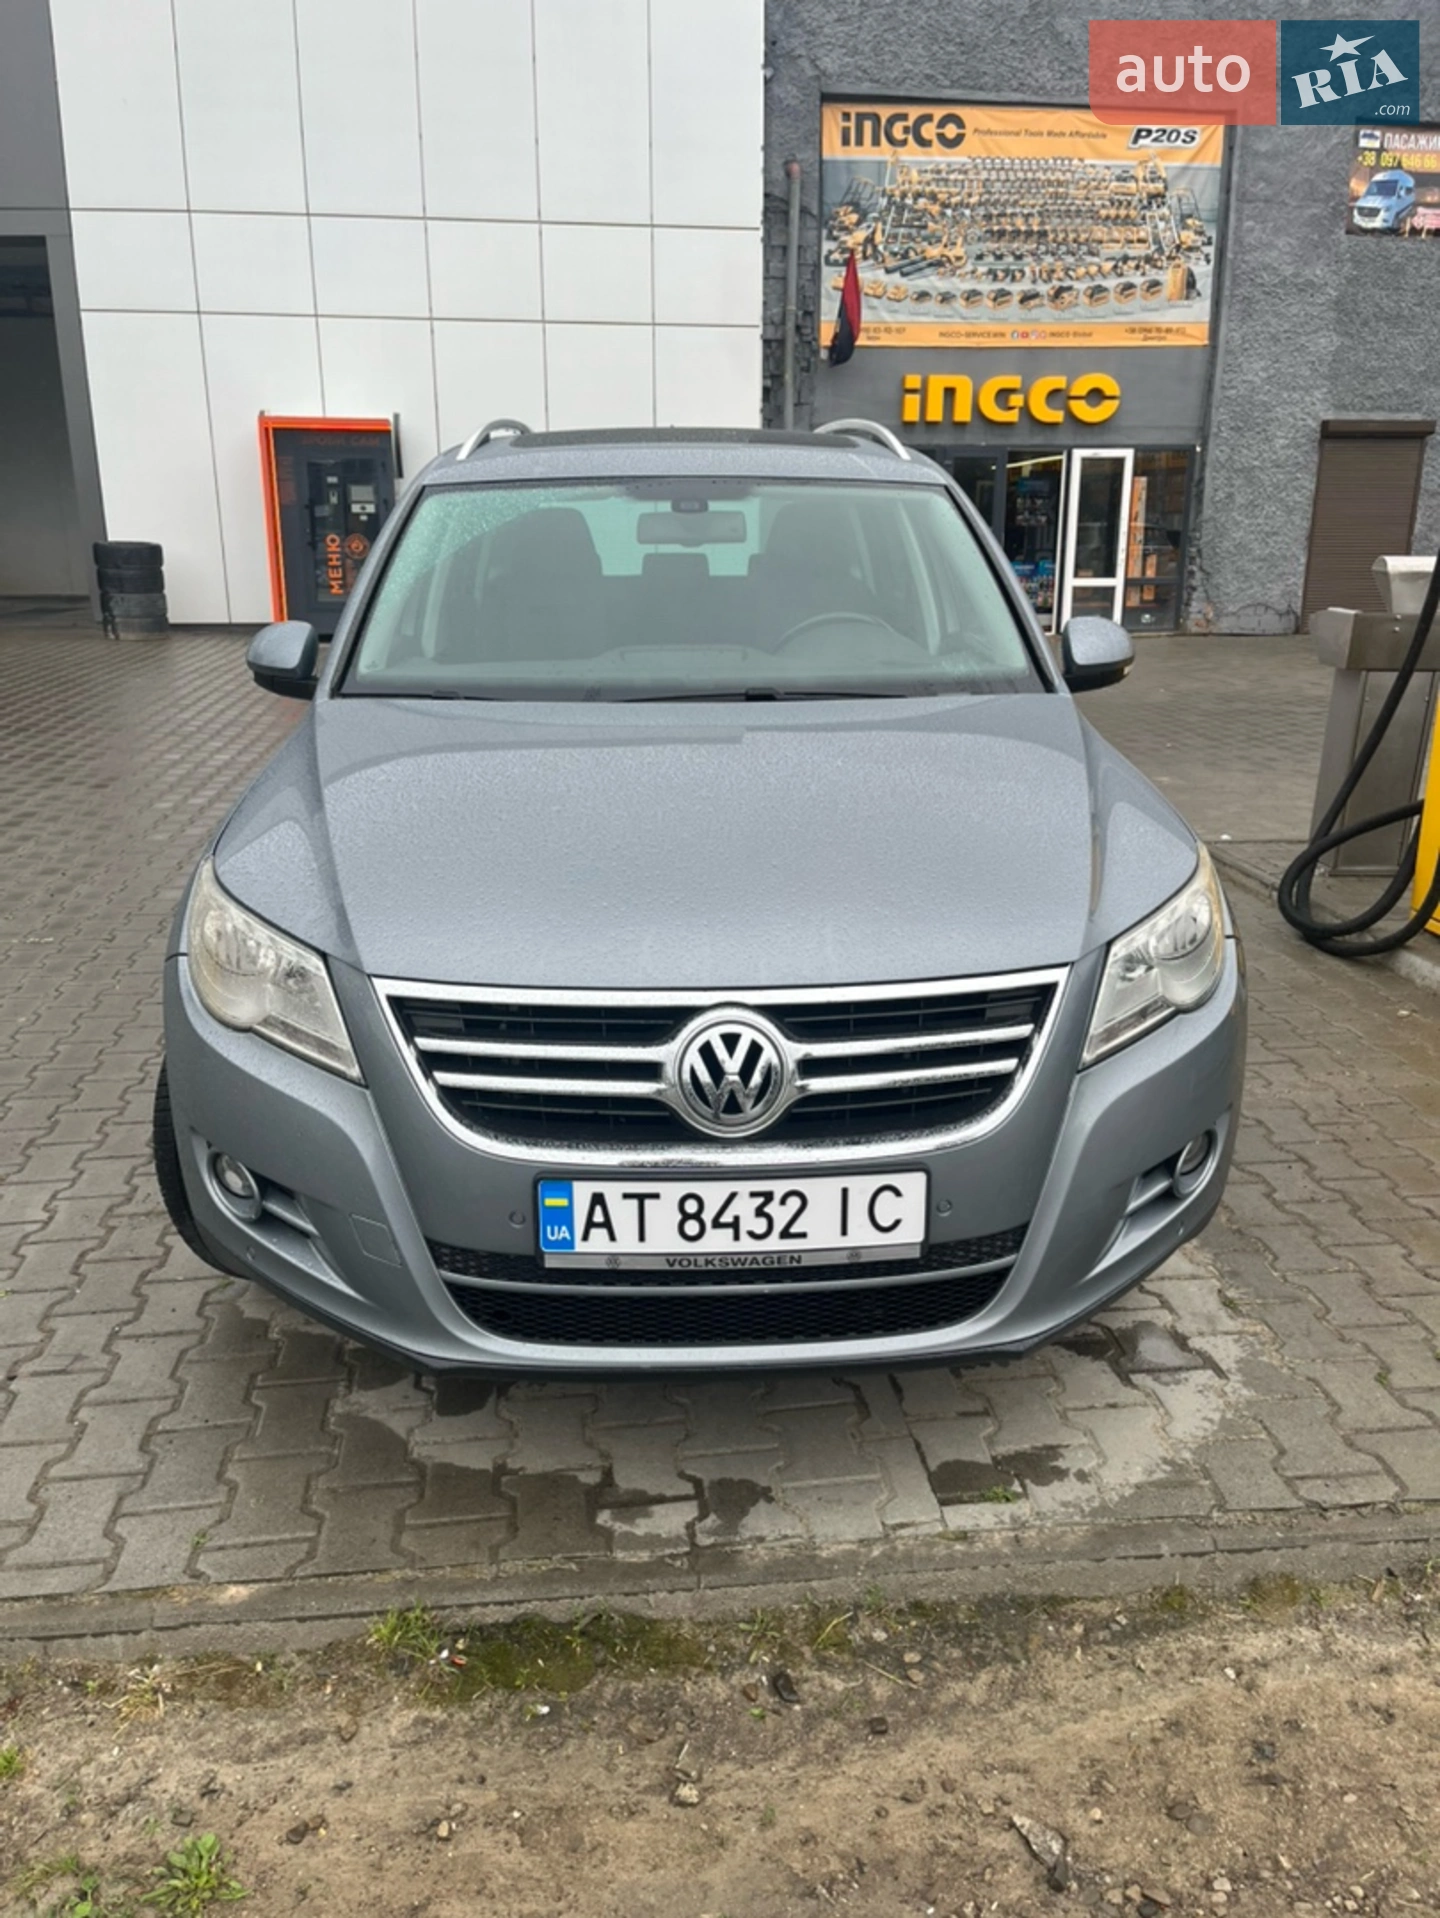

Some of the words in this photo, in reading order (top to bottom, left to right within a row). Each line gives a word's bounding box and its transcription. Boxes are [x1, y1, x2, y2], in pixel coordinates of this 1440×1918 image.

[972, 127, 1022, 138] Professional
[1131, 127, 1199, 146] P20S
[325, 533, 344, 596] МЕНЮ
[580, 1191, 661, 1243] AT
[676, 1189, 809, 1243] 8432
[840, 1183, 904, 1238] IC
[546, 1224, 571, 1241] UA
[665, 1254, 803, 1269] VOLKSWAGEN
